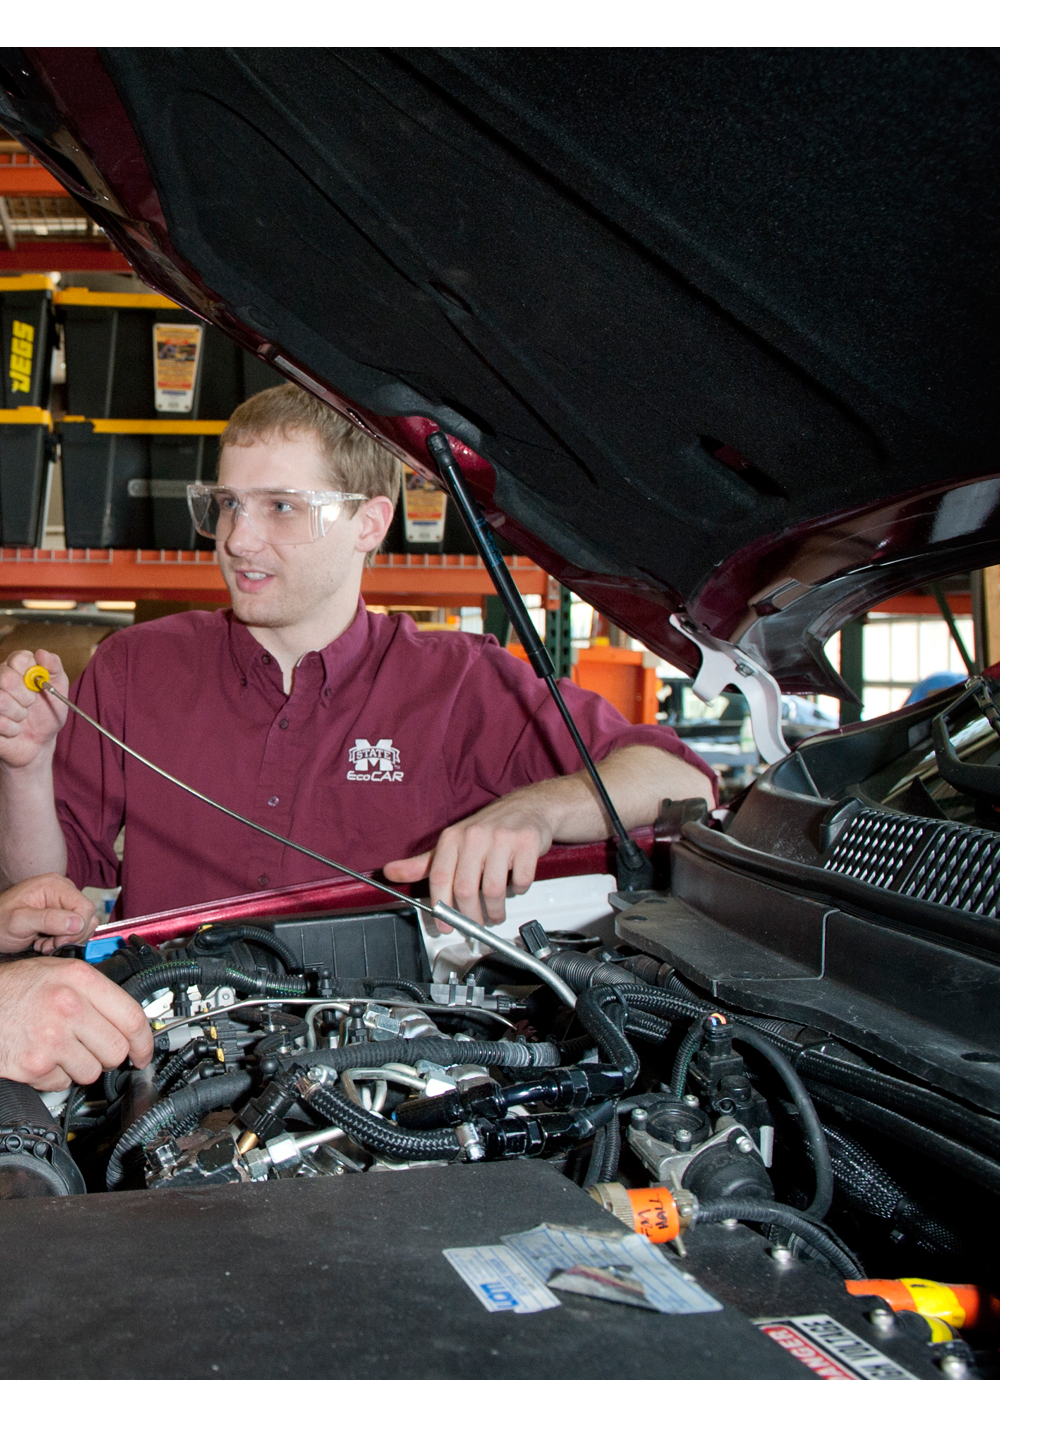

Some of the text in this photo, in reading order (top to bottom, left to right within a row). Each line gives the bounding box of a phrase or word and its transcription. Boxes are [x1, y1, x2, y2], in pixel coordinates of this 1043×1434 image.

[8, 319, 35, 394] JEGS
[355, 747, 392, 761] STATE
[346, 769, 405, 782] EcoCAR
[801, 1319, 881, 1363] VOLTAGE
